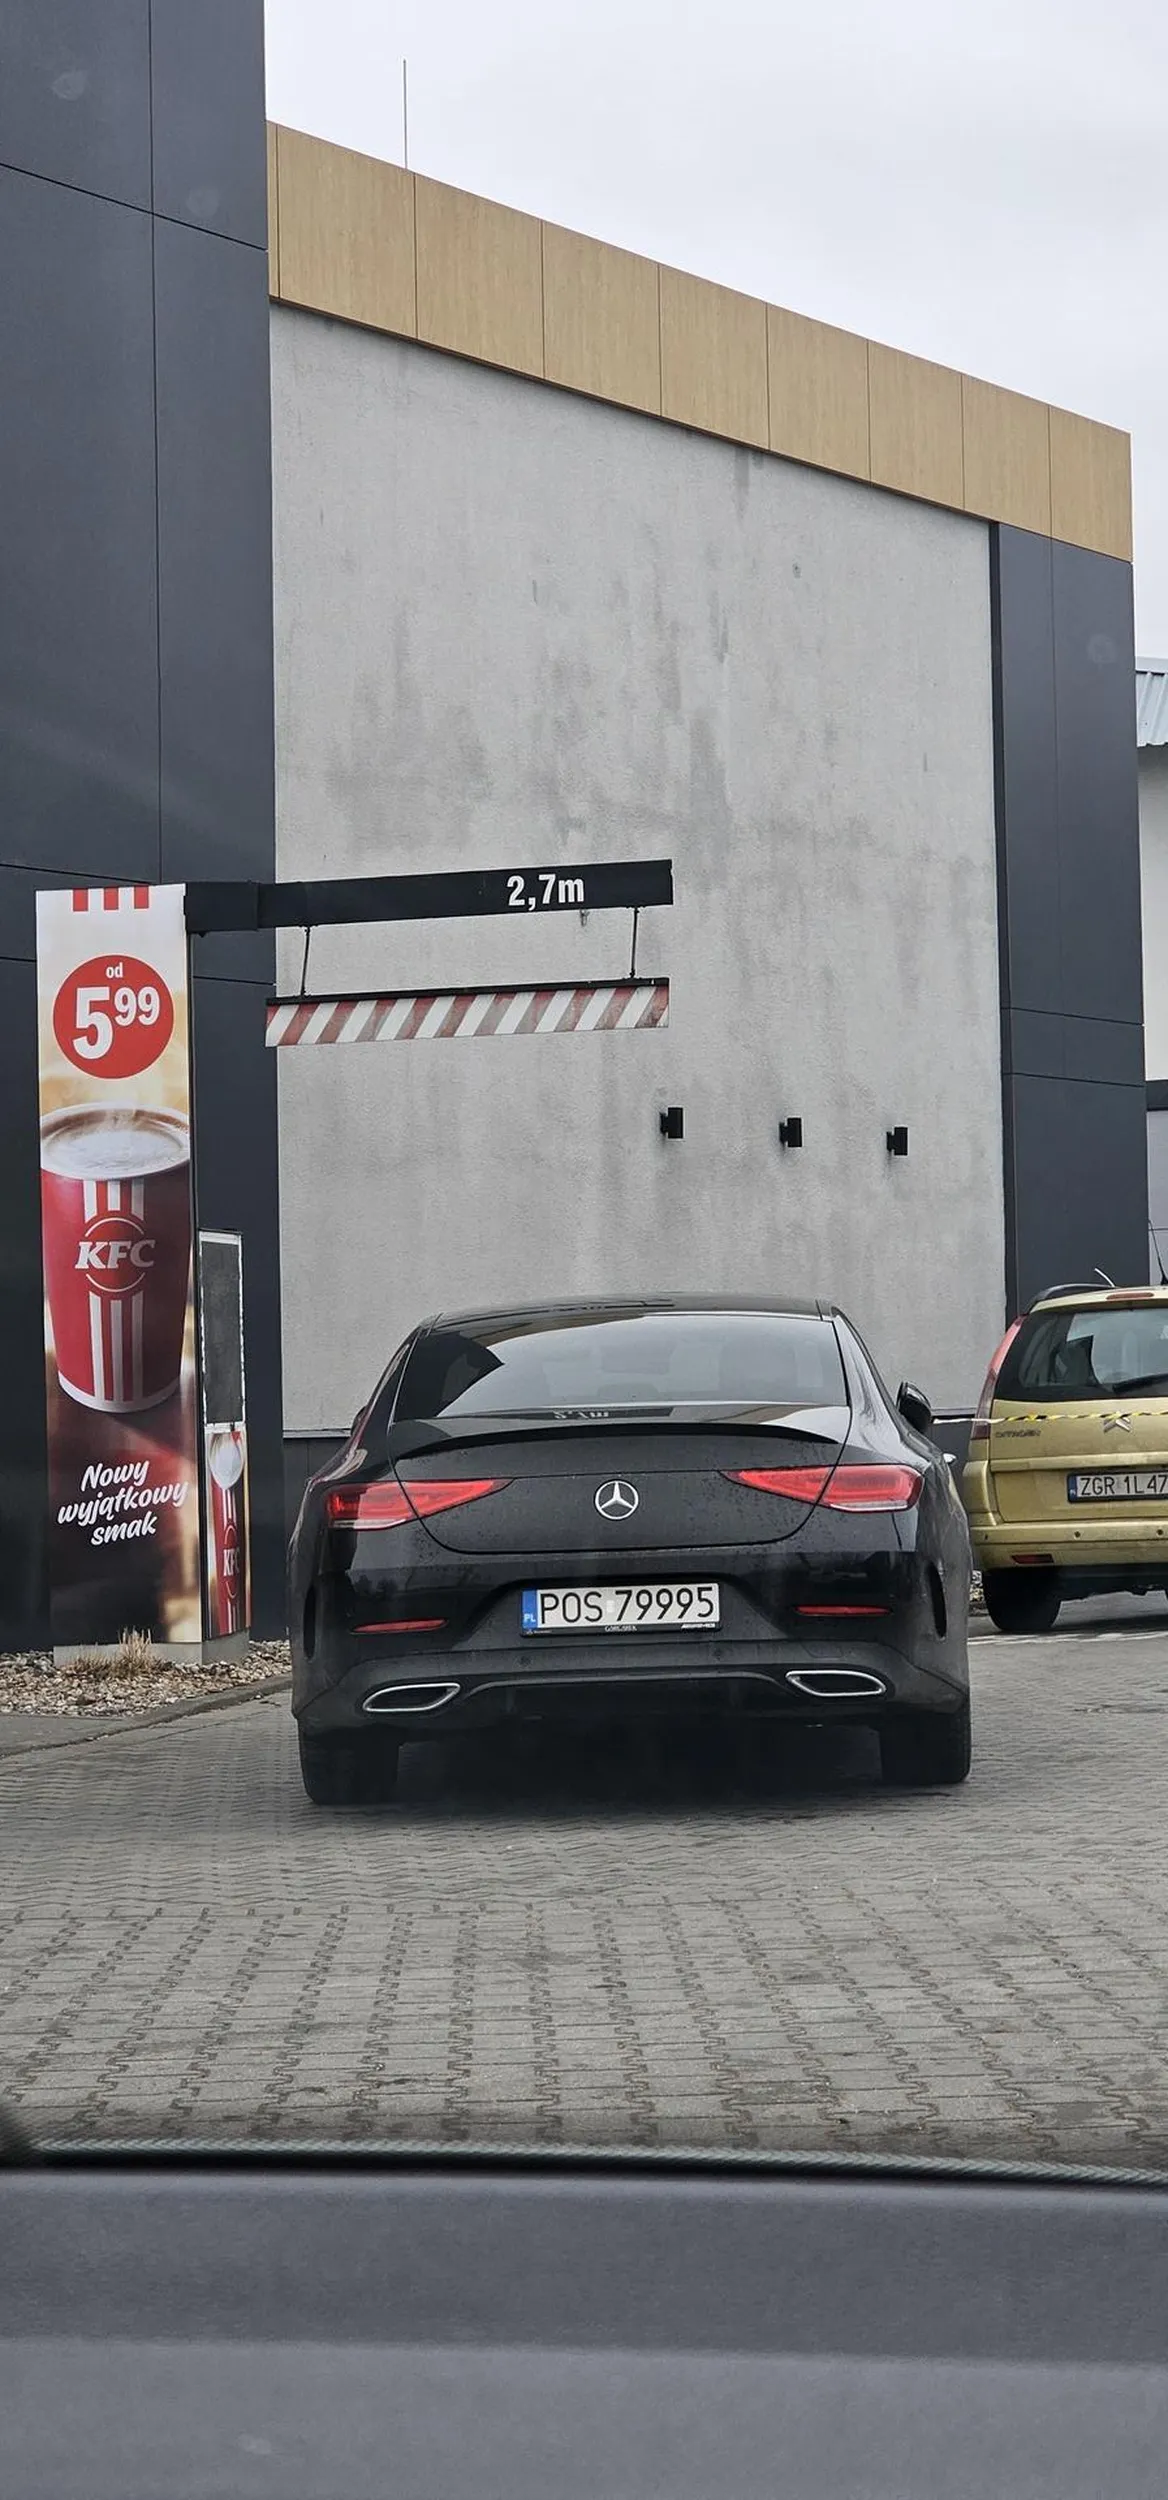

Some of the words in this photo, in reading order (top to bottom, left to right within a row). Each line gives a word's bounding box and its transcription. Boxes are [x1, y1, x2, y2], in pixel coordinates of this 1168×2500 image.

[507, 874, 584, 911] 2,7m
[106, 962, 123, 978] od
[75, 1240, 155, 1269] KFC
[81, 1460, 149, 1491] Nowy
[1080, 1476, 1115, 1495] ZGR
[1124, 1474, 1168, 1494] 1L47
[58, 1482, 188, 1526] wyjątkowy
[91, 1511, 157, 1545] smak
[223, 1548, 240, 1576] KFC
[524, 1613, 536, 1622] PL
[540, 1592, 603, 1624] POS
[616, 1587, 714, 1621] 79995
